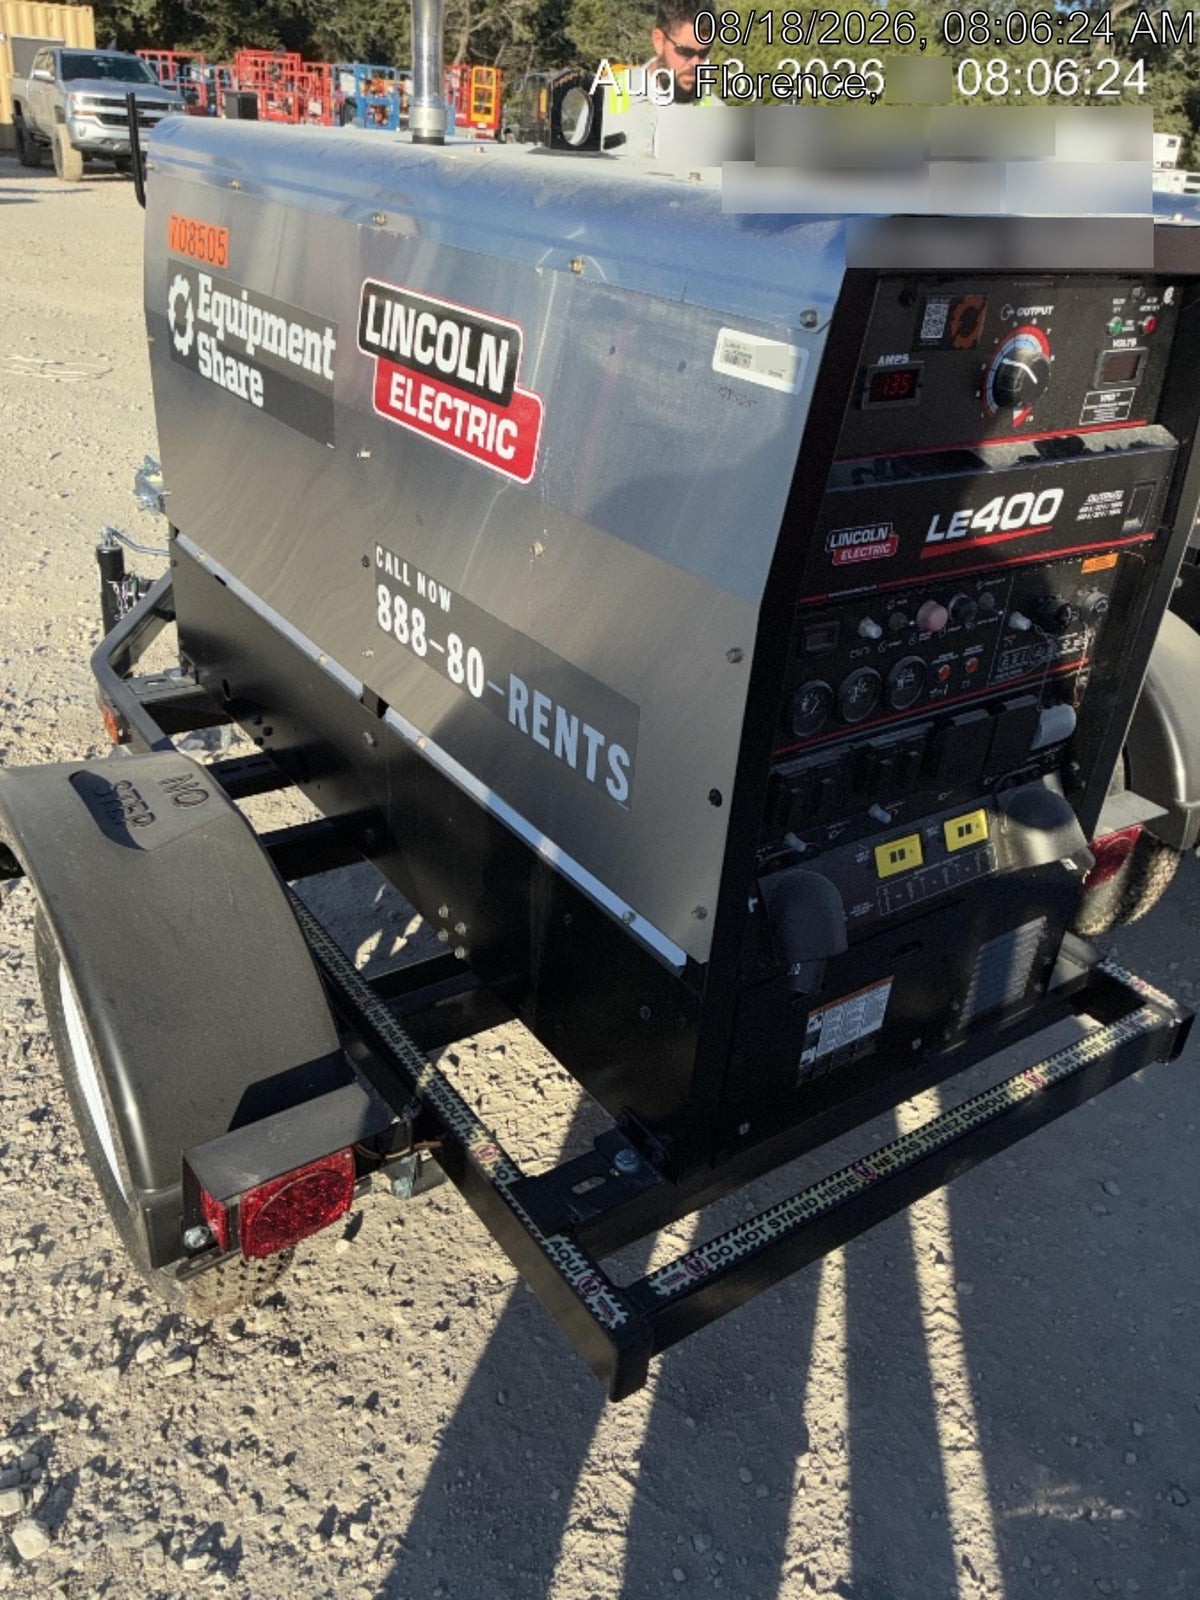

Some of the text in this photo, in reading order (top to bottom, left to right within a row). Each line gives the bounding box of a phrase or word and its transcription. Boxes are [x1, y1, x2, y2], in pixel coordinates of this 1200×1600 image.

[170, 214, 227, 266] 708505
[197, 273, 336, 380] Equipment
[365, 294, 510, 394] LINCOLN
[877, 353, 910, 366] AMPS
[197, 331, 264, 408] Share
[388, 371, 519, 460] ELECTRIC
[829, 526, 890, 548] LINCOLN
[925, 488, 1064, 543] LE400
[376, 545, 451, 612] CALL NOW
[841, 543, 892, 561] ELECTRIC
[377, 584, 631, 802] 888-80-RENTS
[158, 773, 209, 809] NO
[873, 1152, 895, 1170] NE
[894, 1139, 922, 1161] PAS
[920, 1118, 964, 1147] TENEZ
[960, 1091, 1011, 1124] DEBOUT
[706, 1174, 859, 1264] DO NOT STAND HERE
[551, 1241, 583, 1276] AQUI
